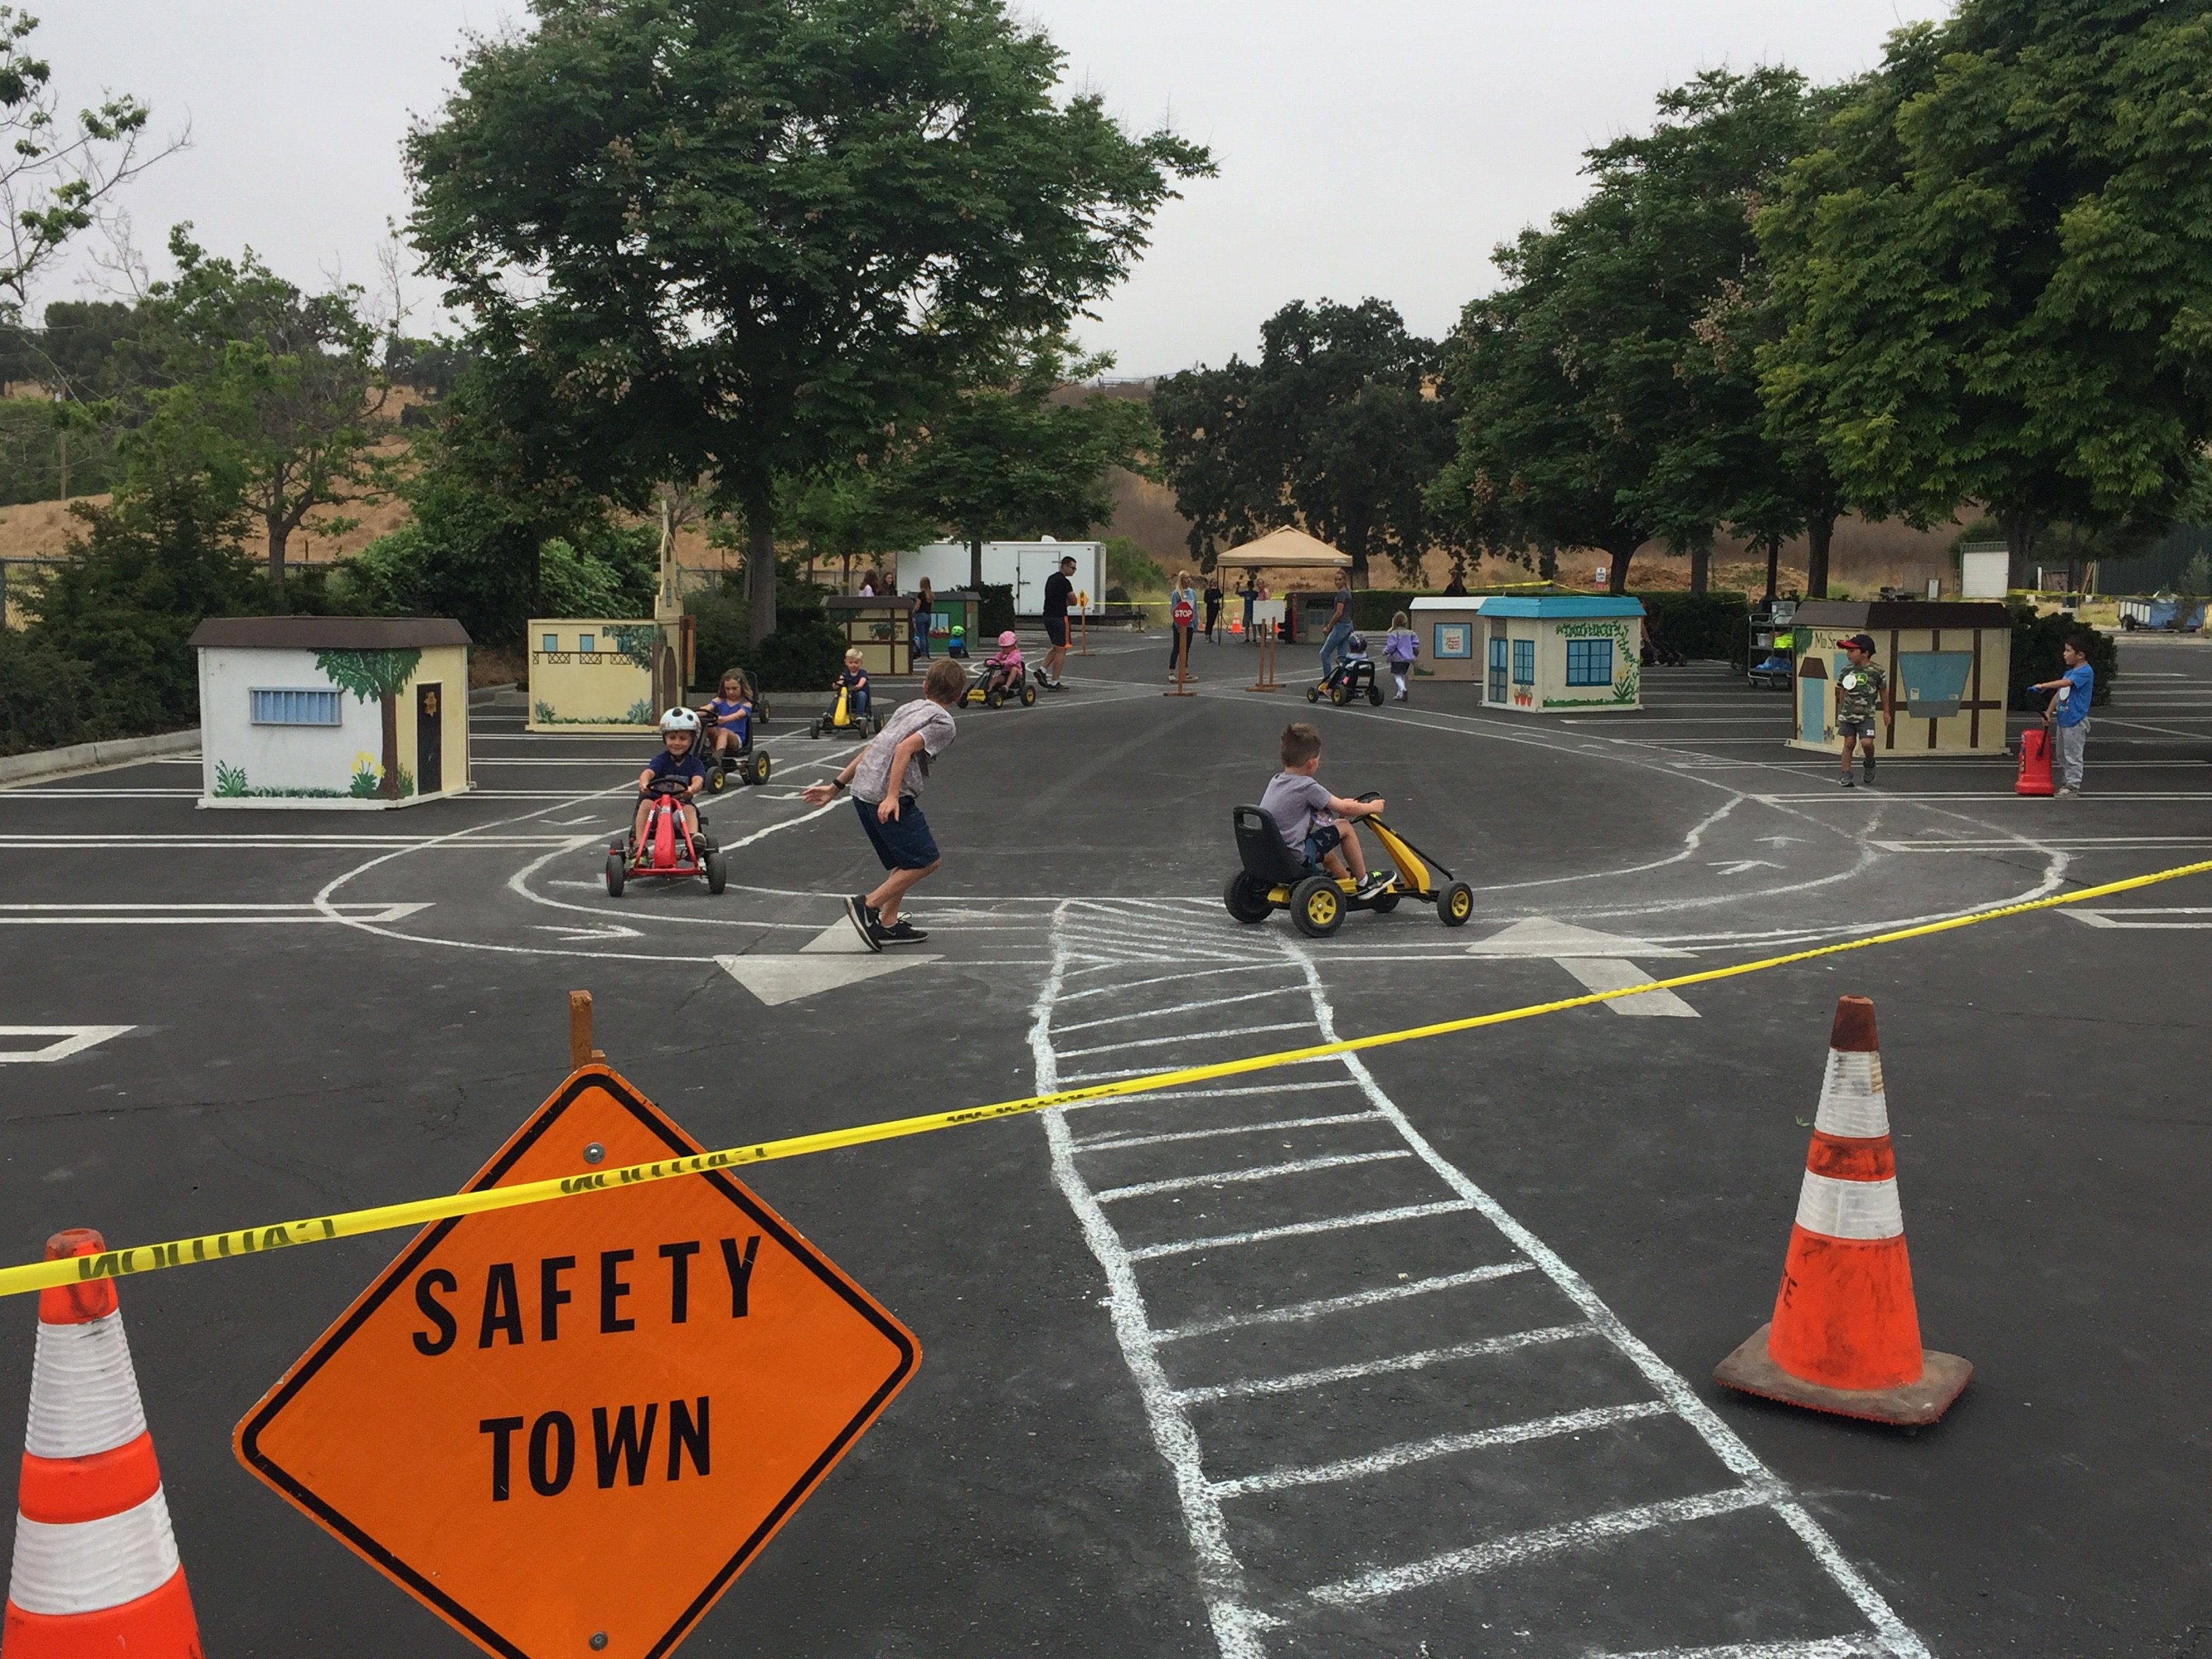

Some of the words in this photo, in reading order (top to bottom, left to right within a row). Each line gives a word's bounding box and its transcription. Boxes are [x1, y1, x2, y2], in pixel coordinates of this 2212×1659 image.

[1174, 609, 1193, 618] STOP
[412, 1235, 762, 1357] SAFETY
[479, 1395, 710, 1502] TOWN
